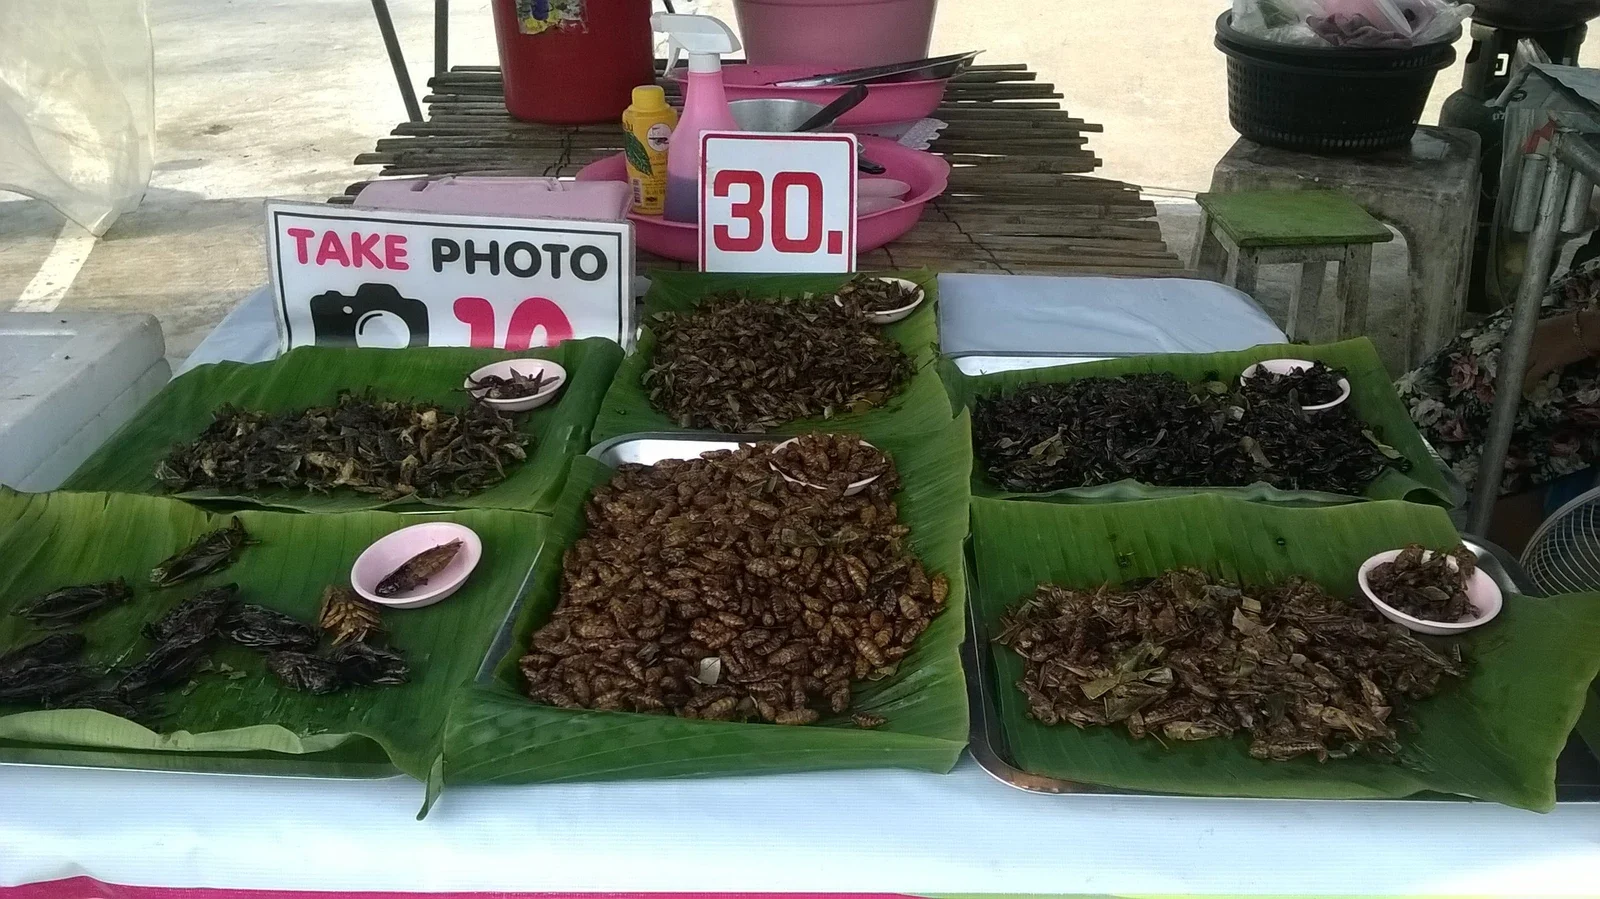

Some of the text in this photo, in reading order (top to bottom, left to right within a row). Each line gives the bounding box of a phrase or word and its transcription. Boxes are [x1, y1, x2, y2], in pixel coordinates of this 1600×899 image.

[713, 169, 843, 254] 30.
[287, 228, 608, 282] TAKE PHOTO
